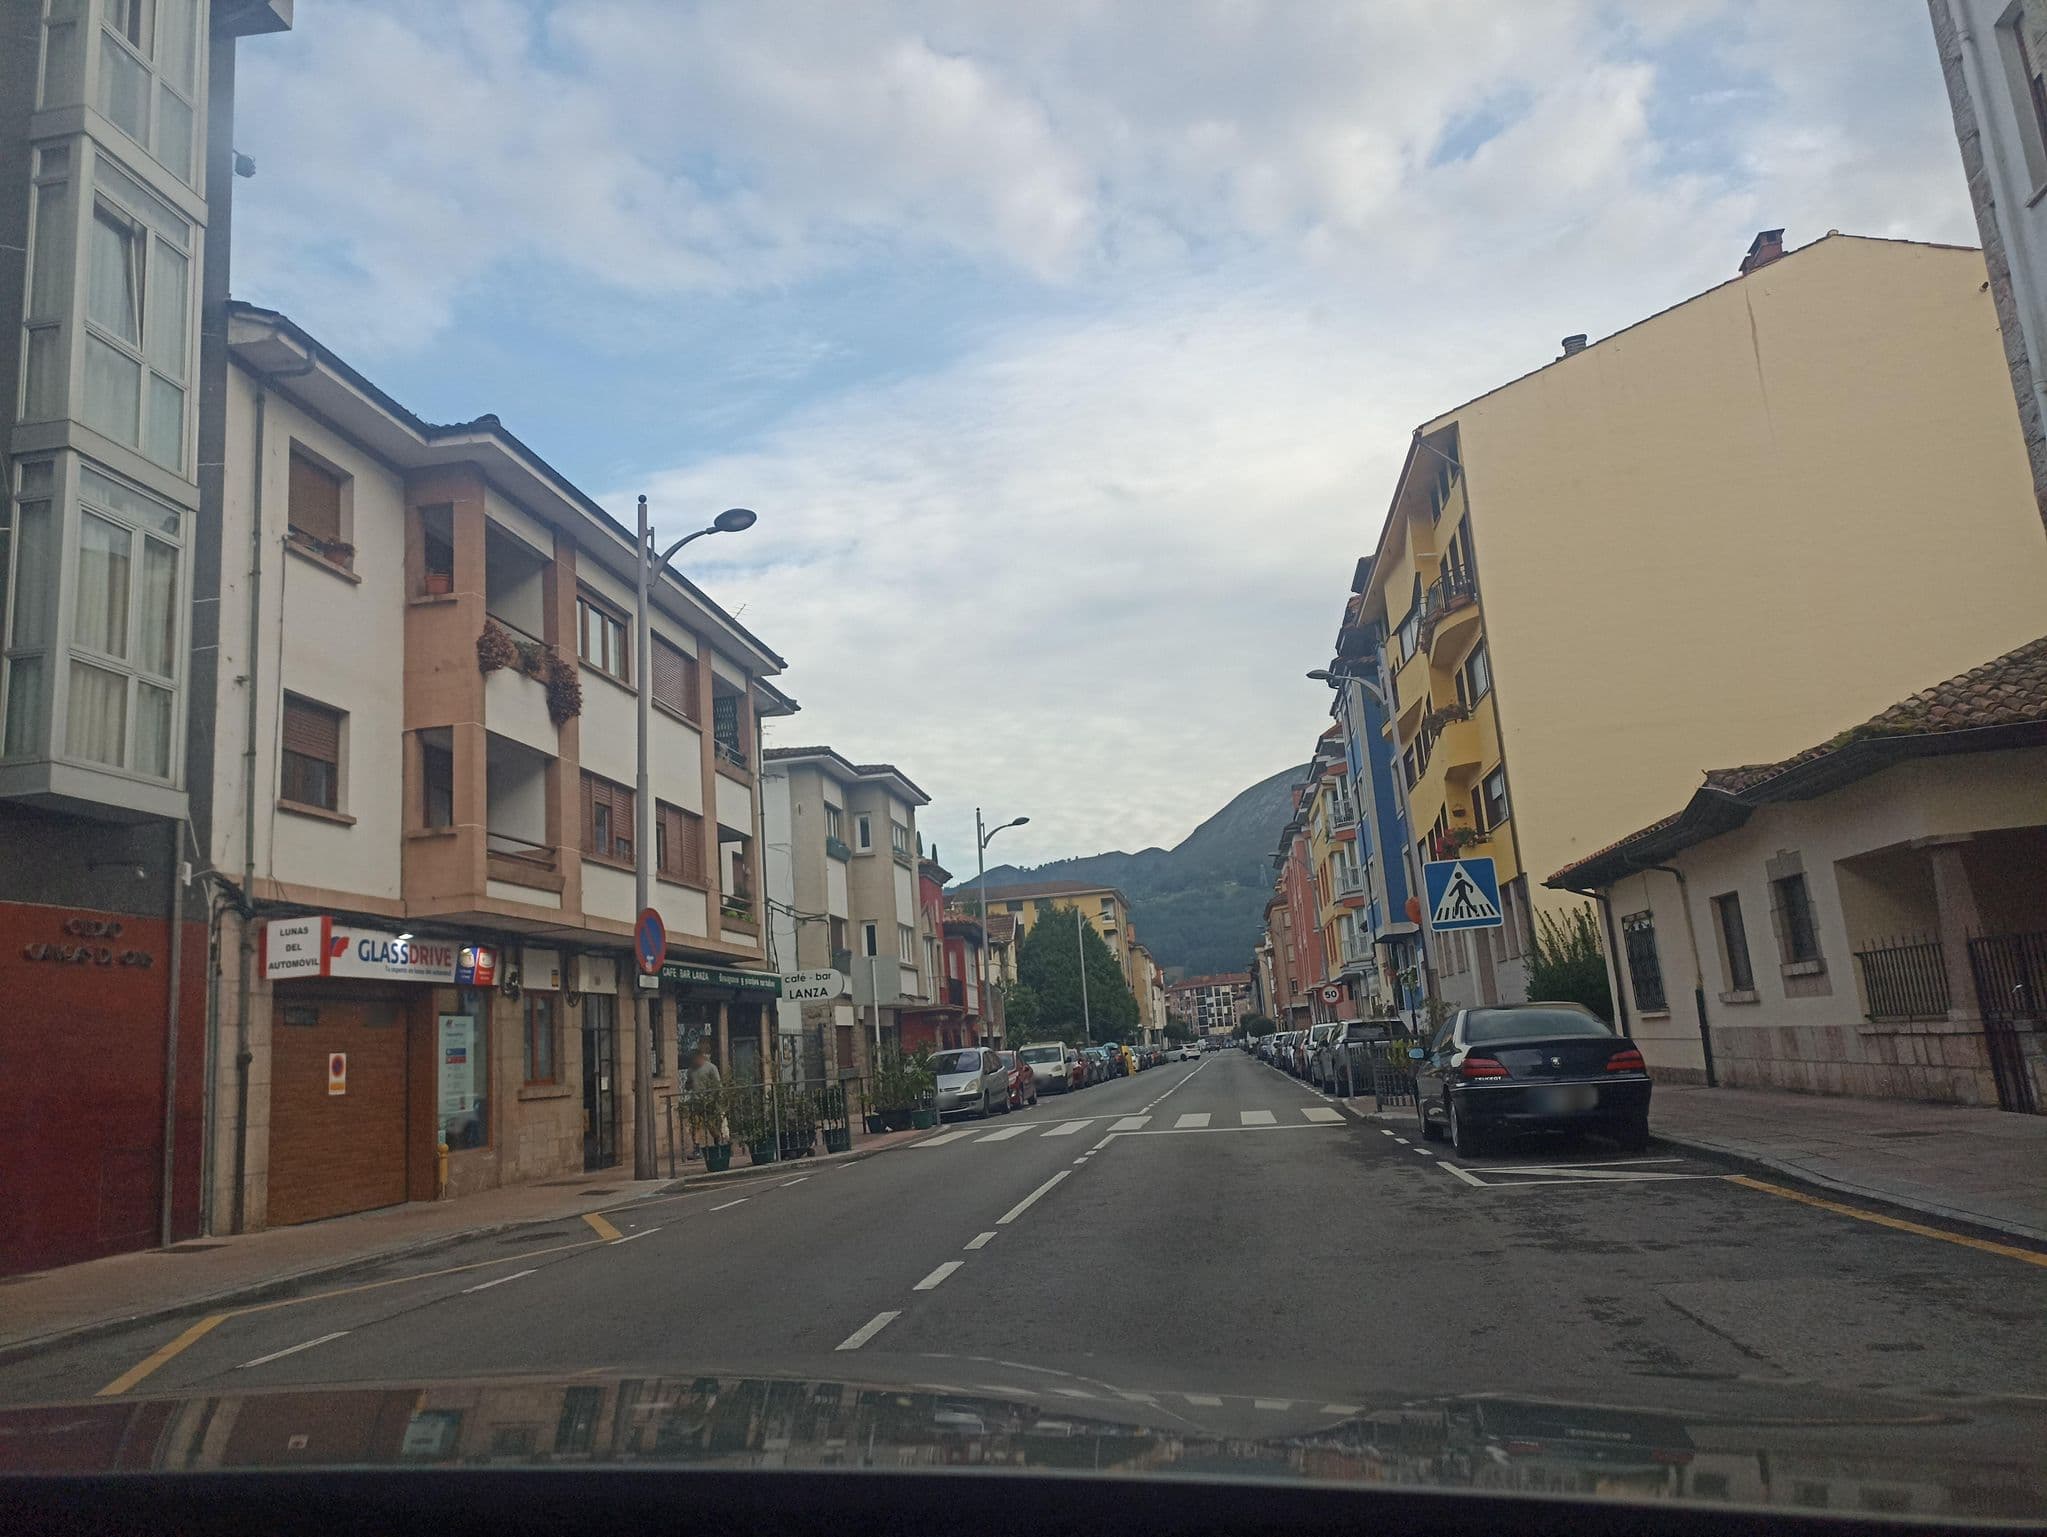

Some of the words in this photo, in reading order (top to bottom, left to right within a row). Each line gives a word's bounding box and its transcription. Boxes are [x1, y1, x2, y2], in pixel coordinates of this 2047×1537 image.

[280, 926, 309, 937] LUNAS
[285, 944, 302, 952] DEL
[358, 939, 452, 967] GLASSDRIVE
[680, 969, 691, 978] BAR
[692, 971, 709, 981] LANZA
[815, 972, 831, 981] bar
[789, 987, 828, 999] LANZA
[1325, 990, 1337, 998] 50
